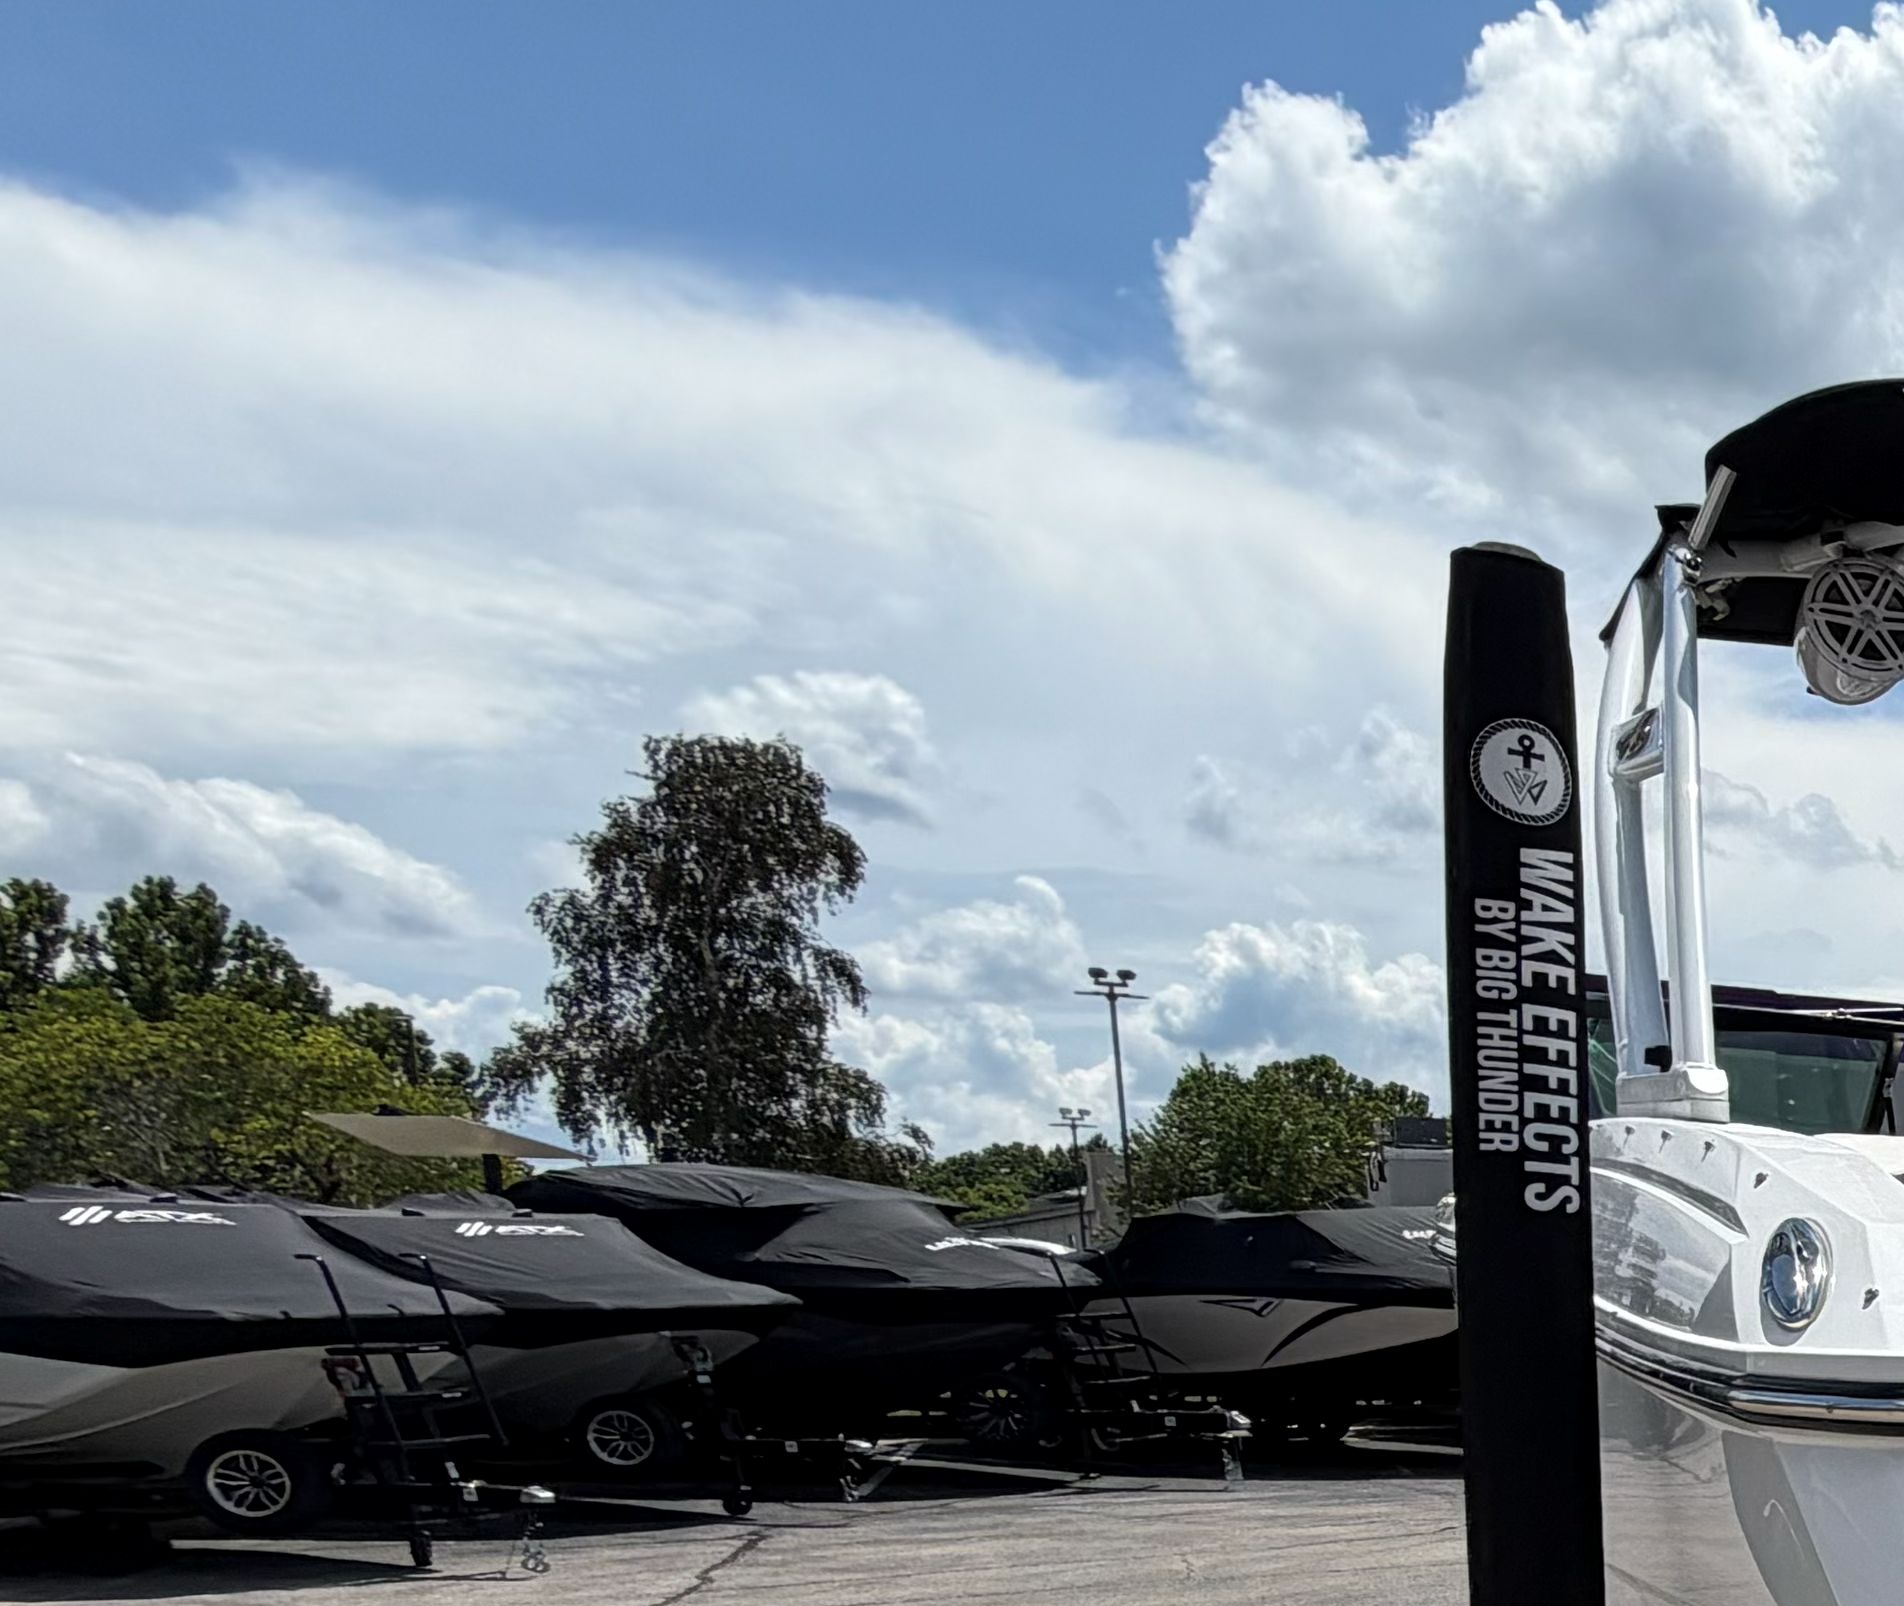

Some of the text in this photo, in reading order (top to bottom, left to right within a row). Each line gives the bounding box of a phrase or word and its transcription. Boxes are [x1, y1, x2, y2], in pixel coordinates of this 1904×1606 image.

[1474, 897, 1520, 1153] BY BIG THUNDER
[1520, 847, 1581, 1214] WAKE EFFECTS
